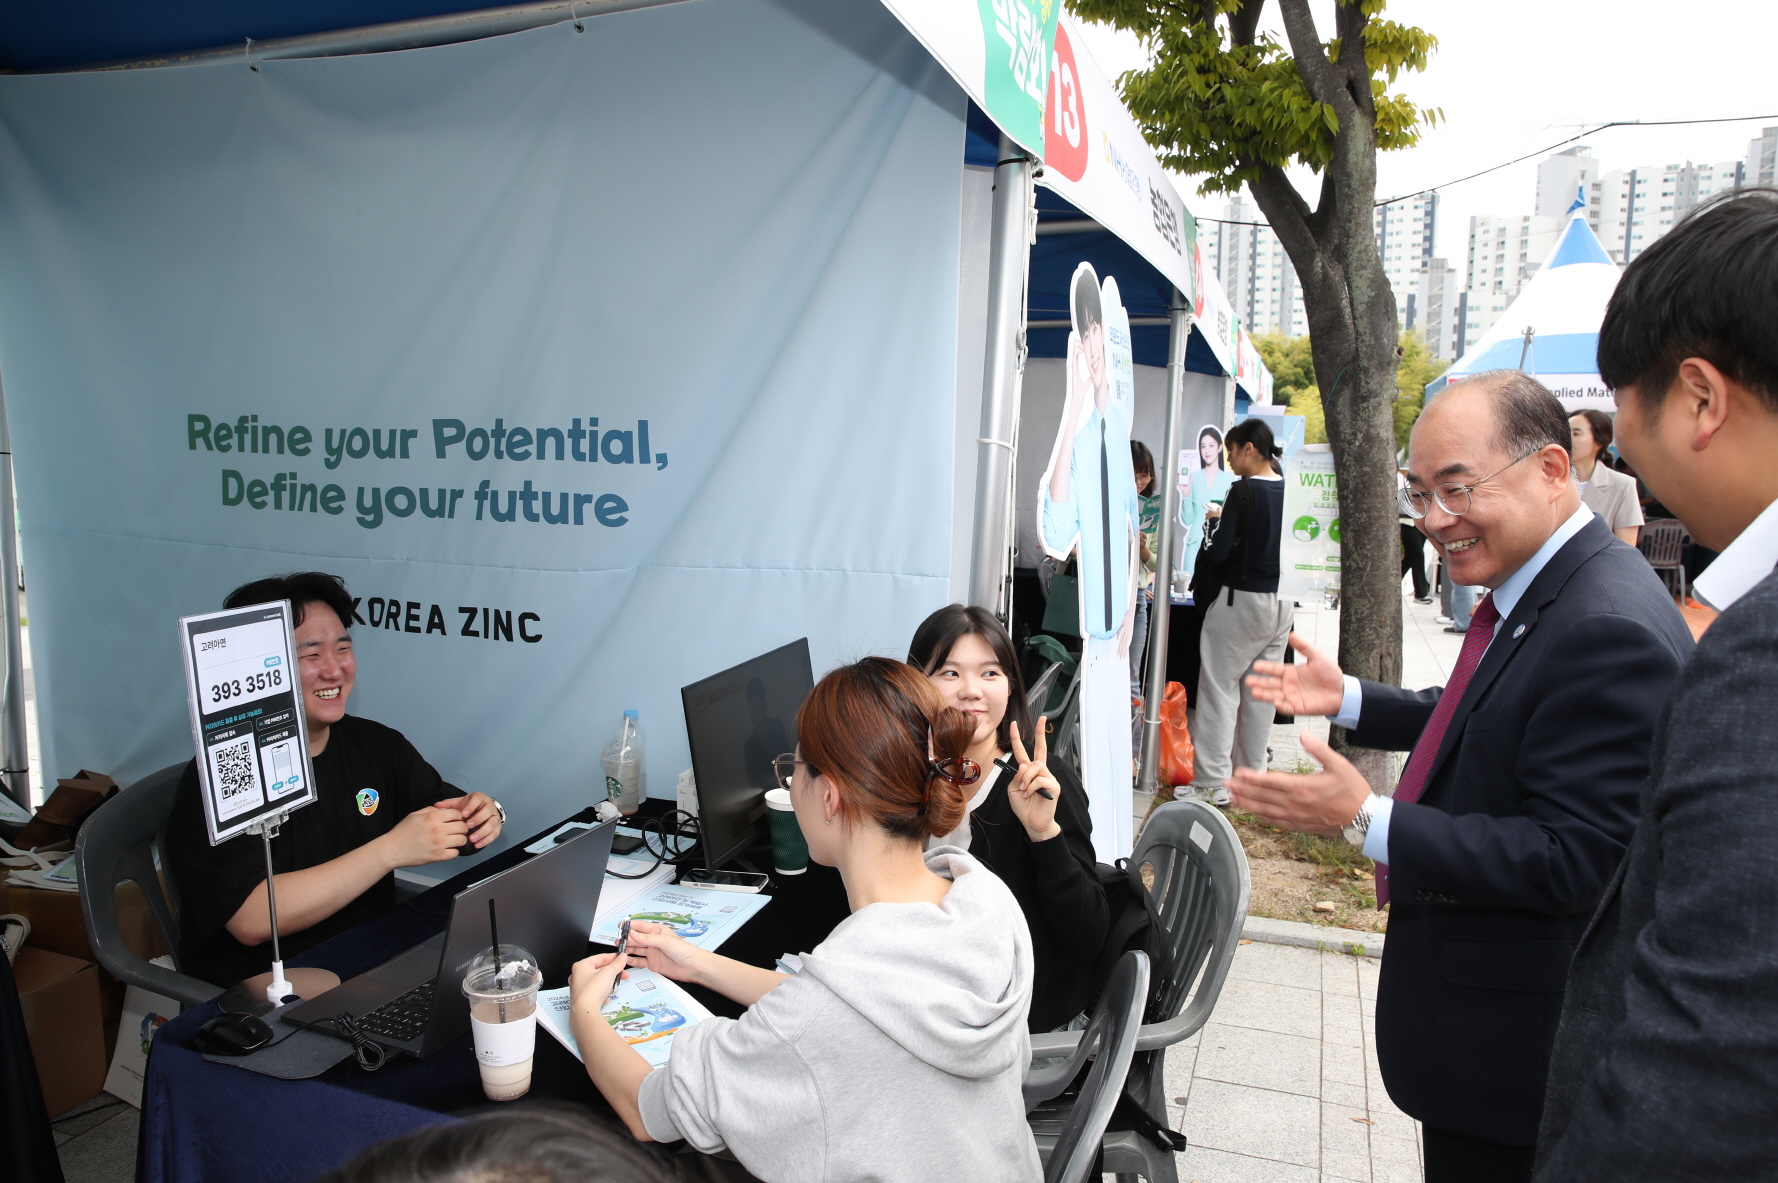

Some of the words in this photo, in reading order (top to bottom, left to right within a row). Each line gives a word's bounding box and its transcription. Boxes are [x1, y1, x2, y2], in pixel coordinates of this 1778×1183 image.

[1052, 49, 1080, 149] 13
[187, 413, 313, 457] Refine
[324, 425, 418, 470] your
[432, 417, 669, 471] Potential,
[221, 469, 346, 514] Define
[356, 486, 464, 529] your
[475, 479, 630, 528] future
[201, 637, 227, 651] 고려아연
[351, 597, 447, 636] KOREA
[458, 606, 543, 643] ZINC
[211, 679, 242, 703] 393
[245, 669, 282, 693] 3518
